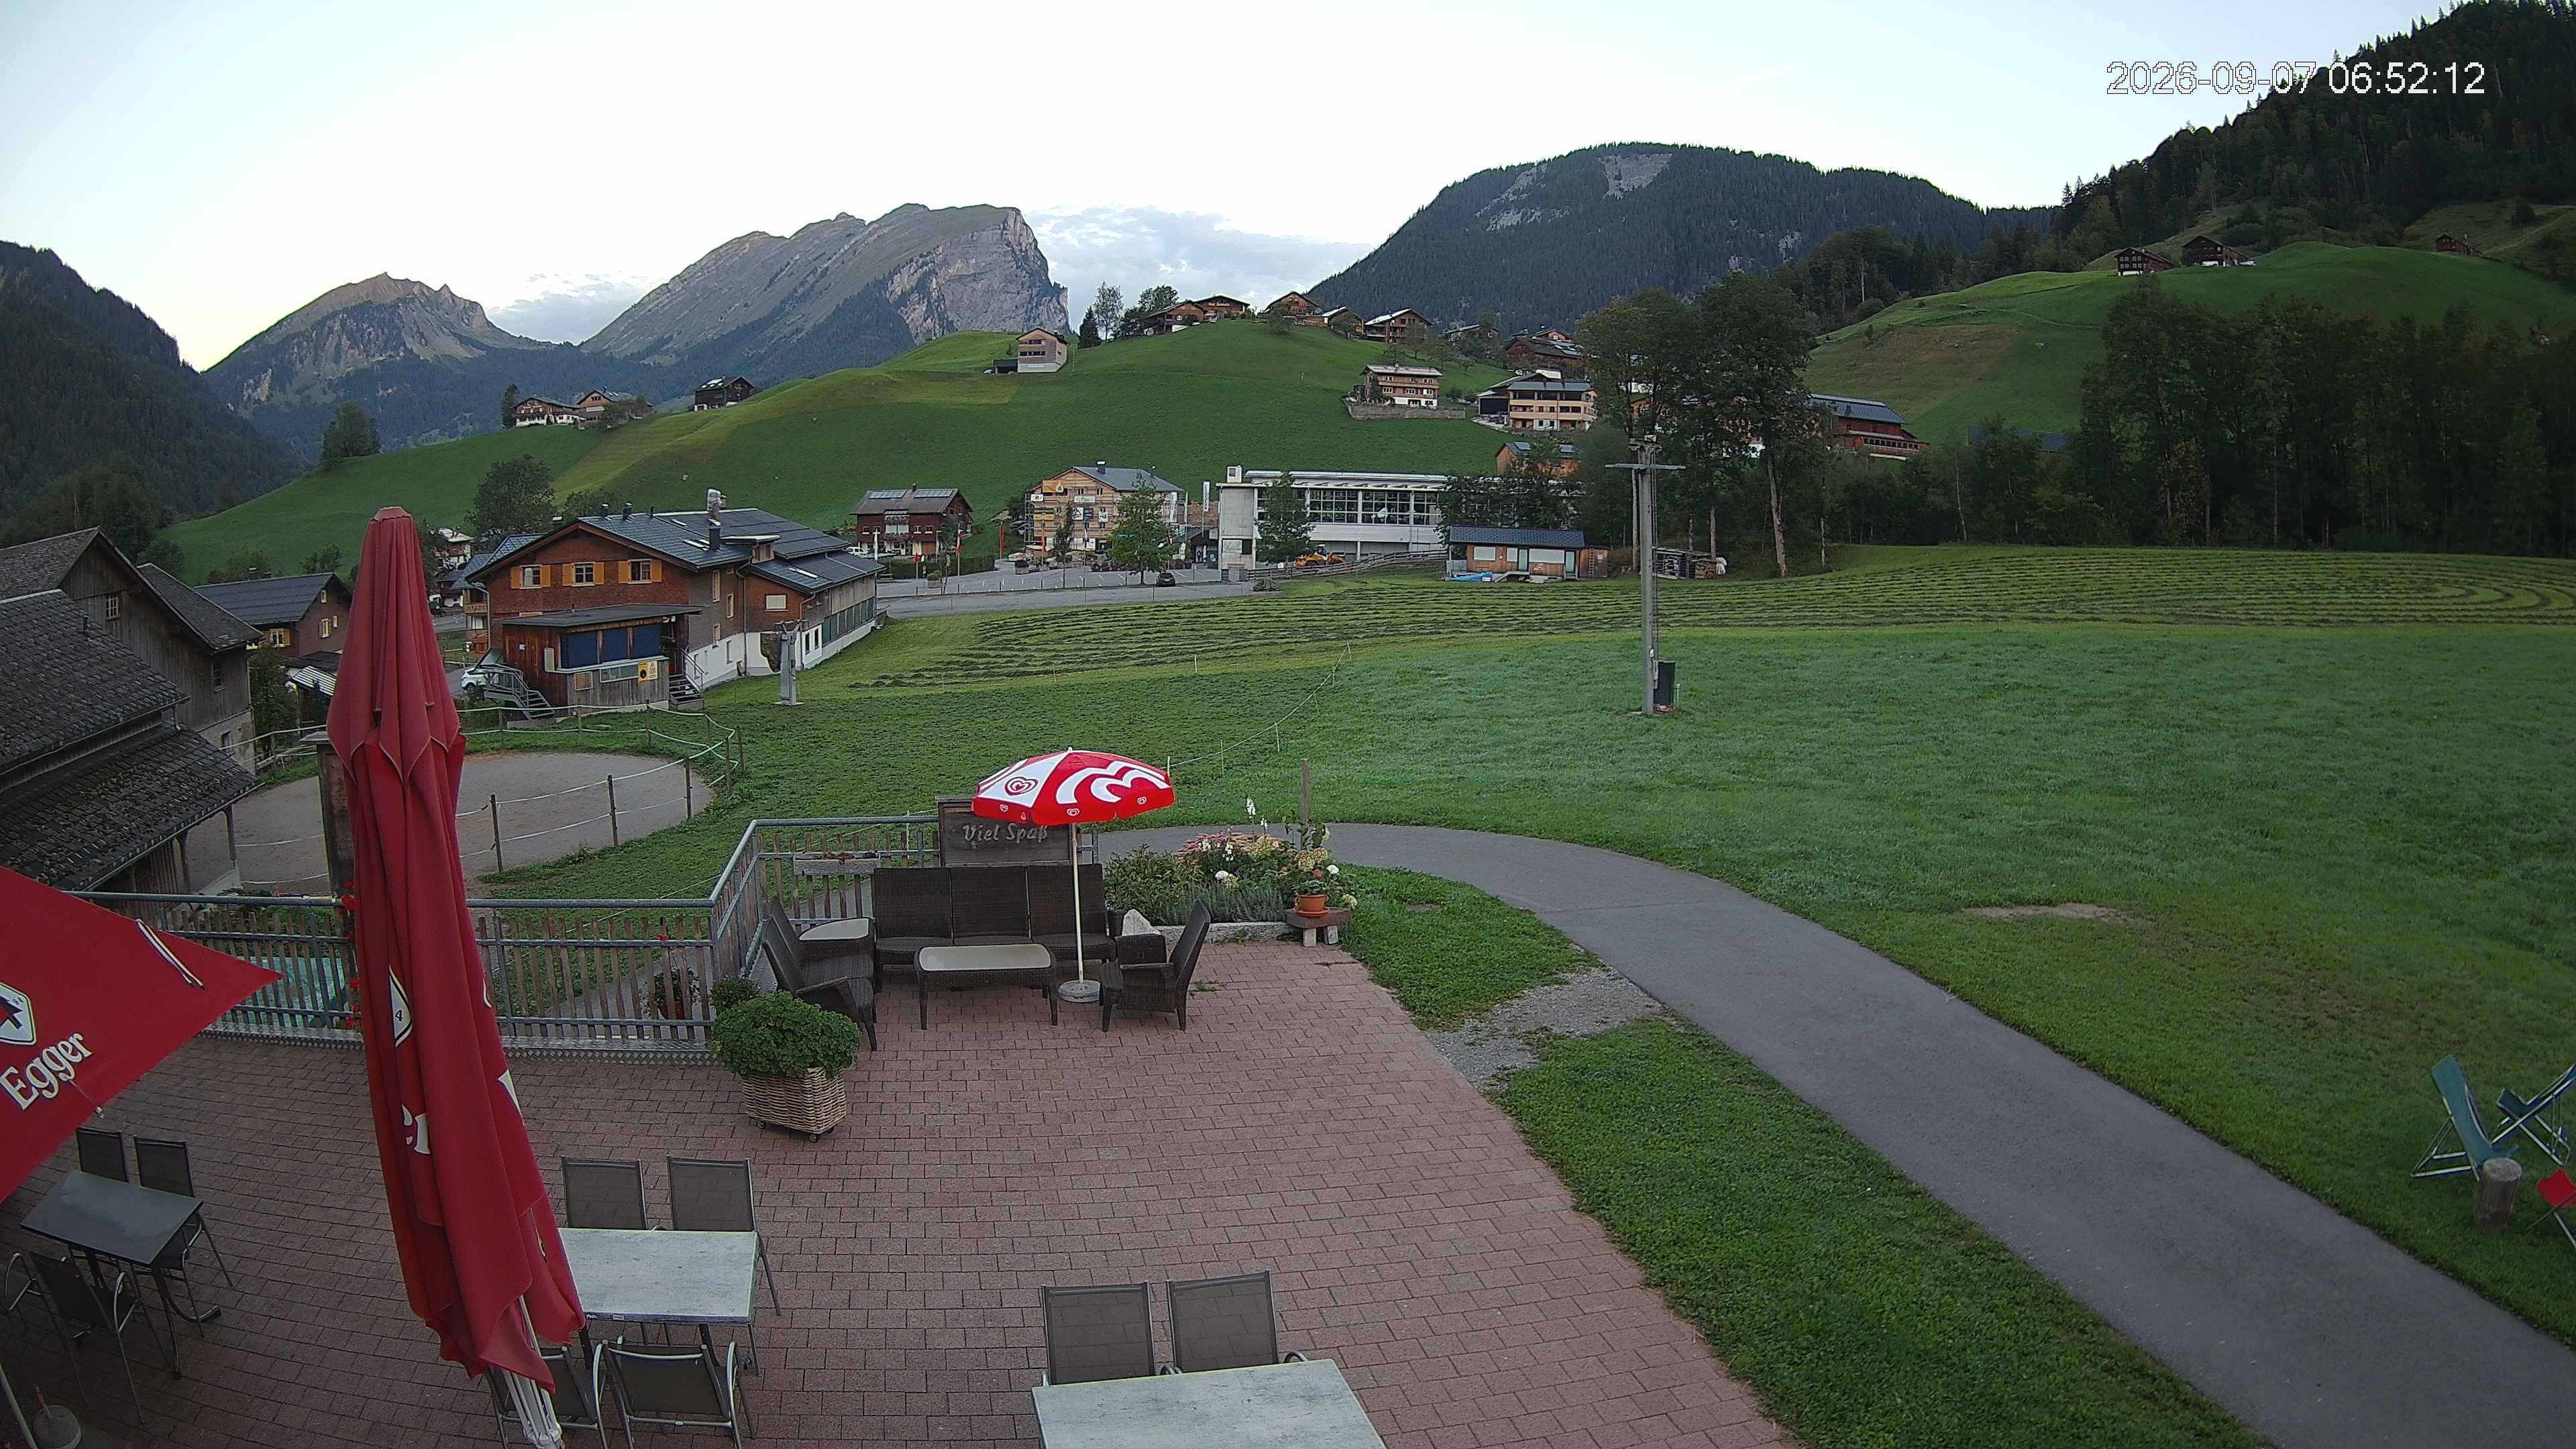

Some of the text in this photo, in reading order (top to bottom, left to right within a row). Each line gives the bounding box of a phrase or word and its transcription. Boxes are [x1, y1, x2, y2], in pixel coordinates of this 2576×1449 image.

[963, 822, 1048, 844] Viel Spaß
[0, 1033, 93, 1110] Egger
